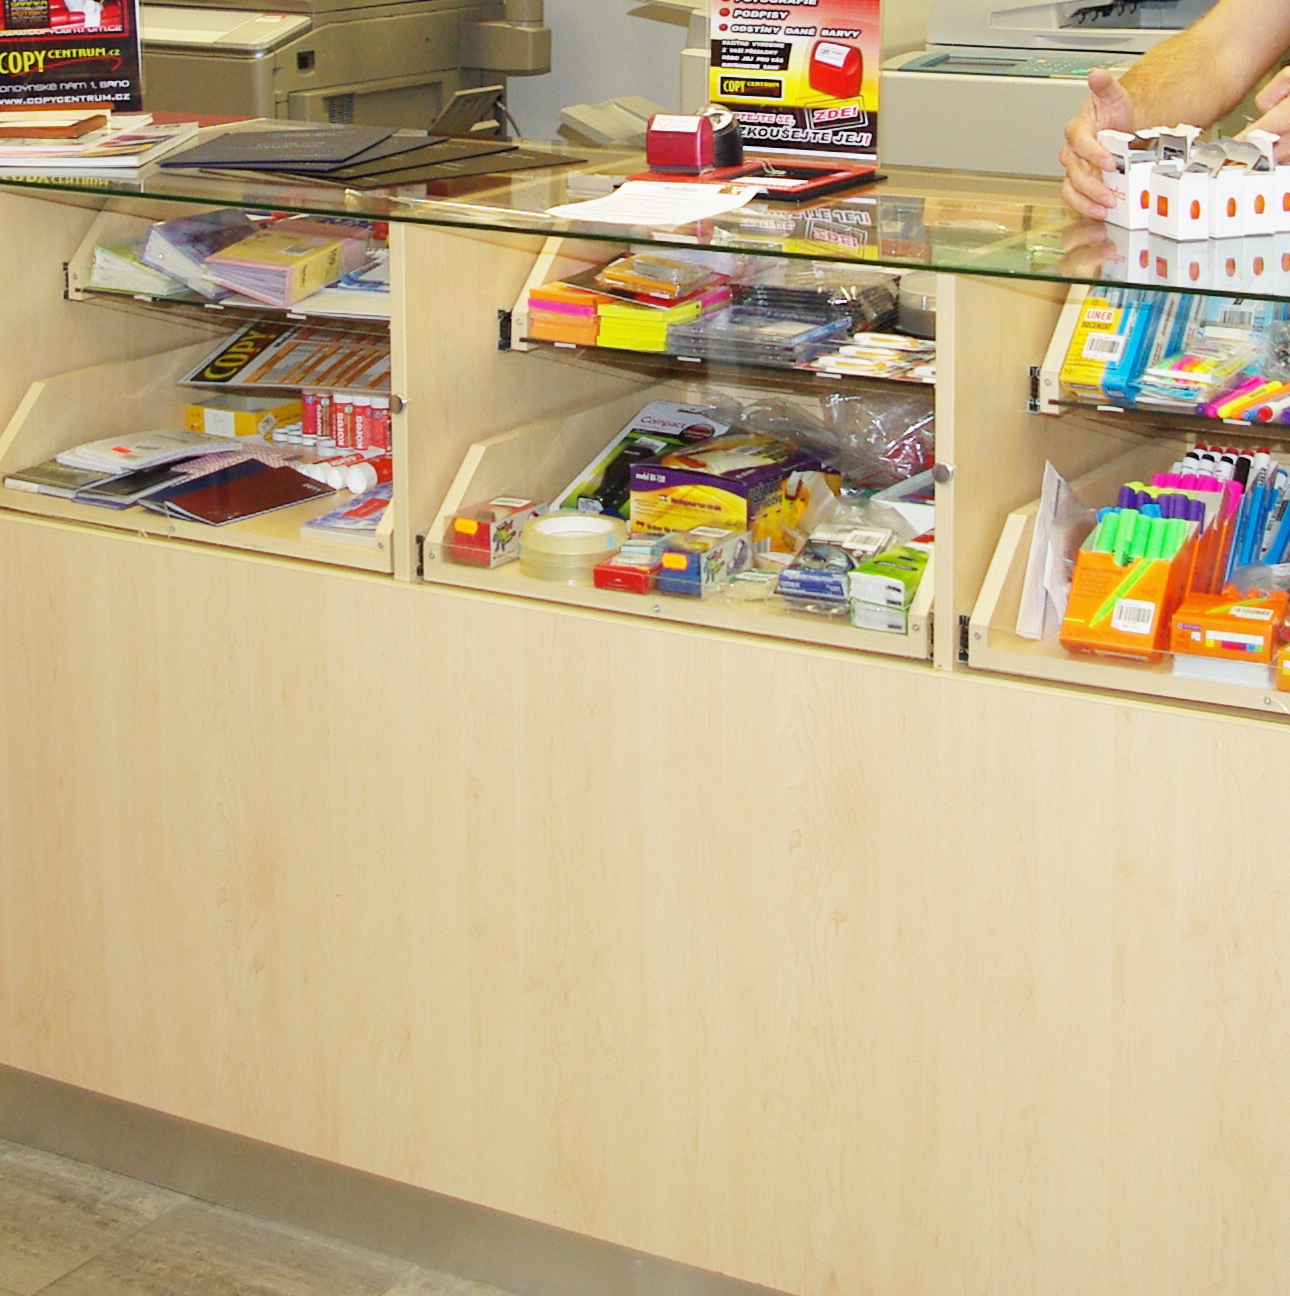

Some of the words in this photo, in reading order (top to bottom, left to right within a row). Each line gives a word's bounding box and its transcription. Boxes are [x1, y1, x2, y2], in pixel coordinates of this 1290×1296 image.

[733, 9, 789, 20] PODPISY
[731, 24, 780, 36] ODSTÍNY
[820, 28, 861, 39] BARVY
[813, 106, 858, 122] ZDE!
[1086, 309, 1113, 321] LINER
